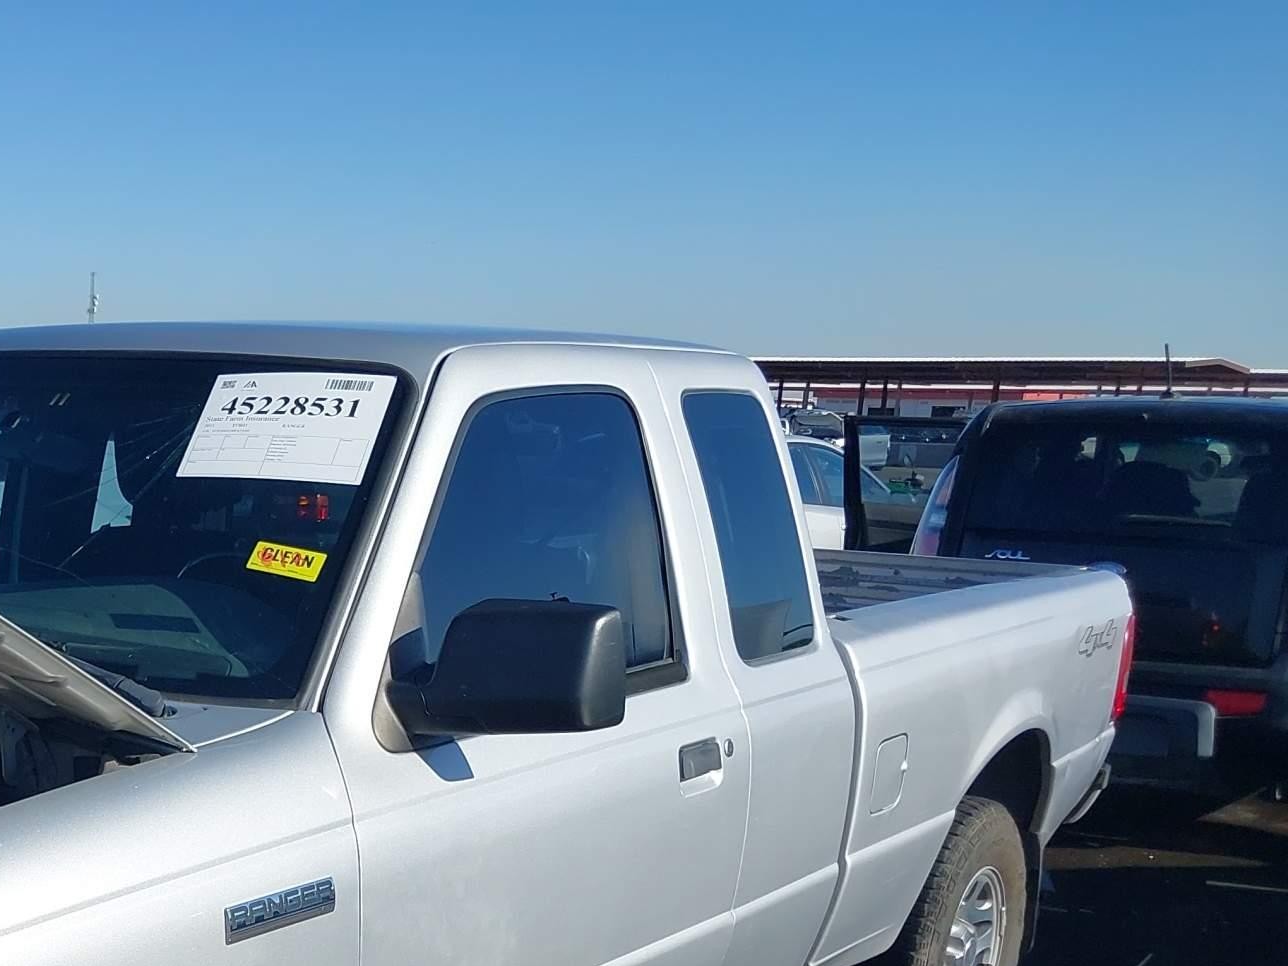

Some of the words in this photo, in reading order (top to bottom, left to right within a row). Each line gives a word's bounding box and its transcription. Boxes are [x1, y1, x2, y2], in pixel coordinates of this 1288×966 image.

[221, 396, 361, 418] 45228531
[262, 547, 315, 568] CLEAN
[229, 879, 334, 929] RANGER
